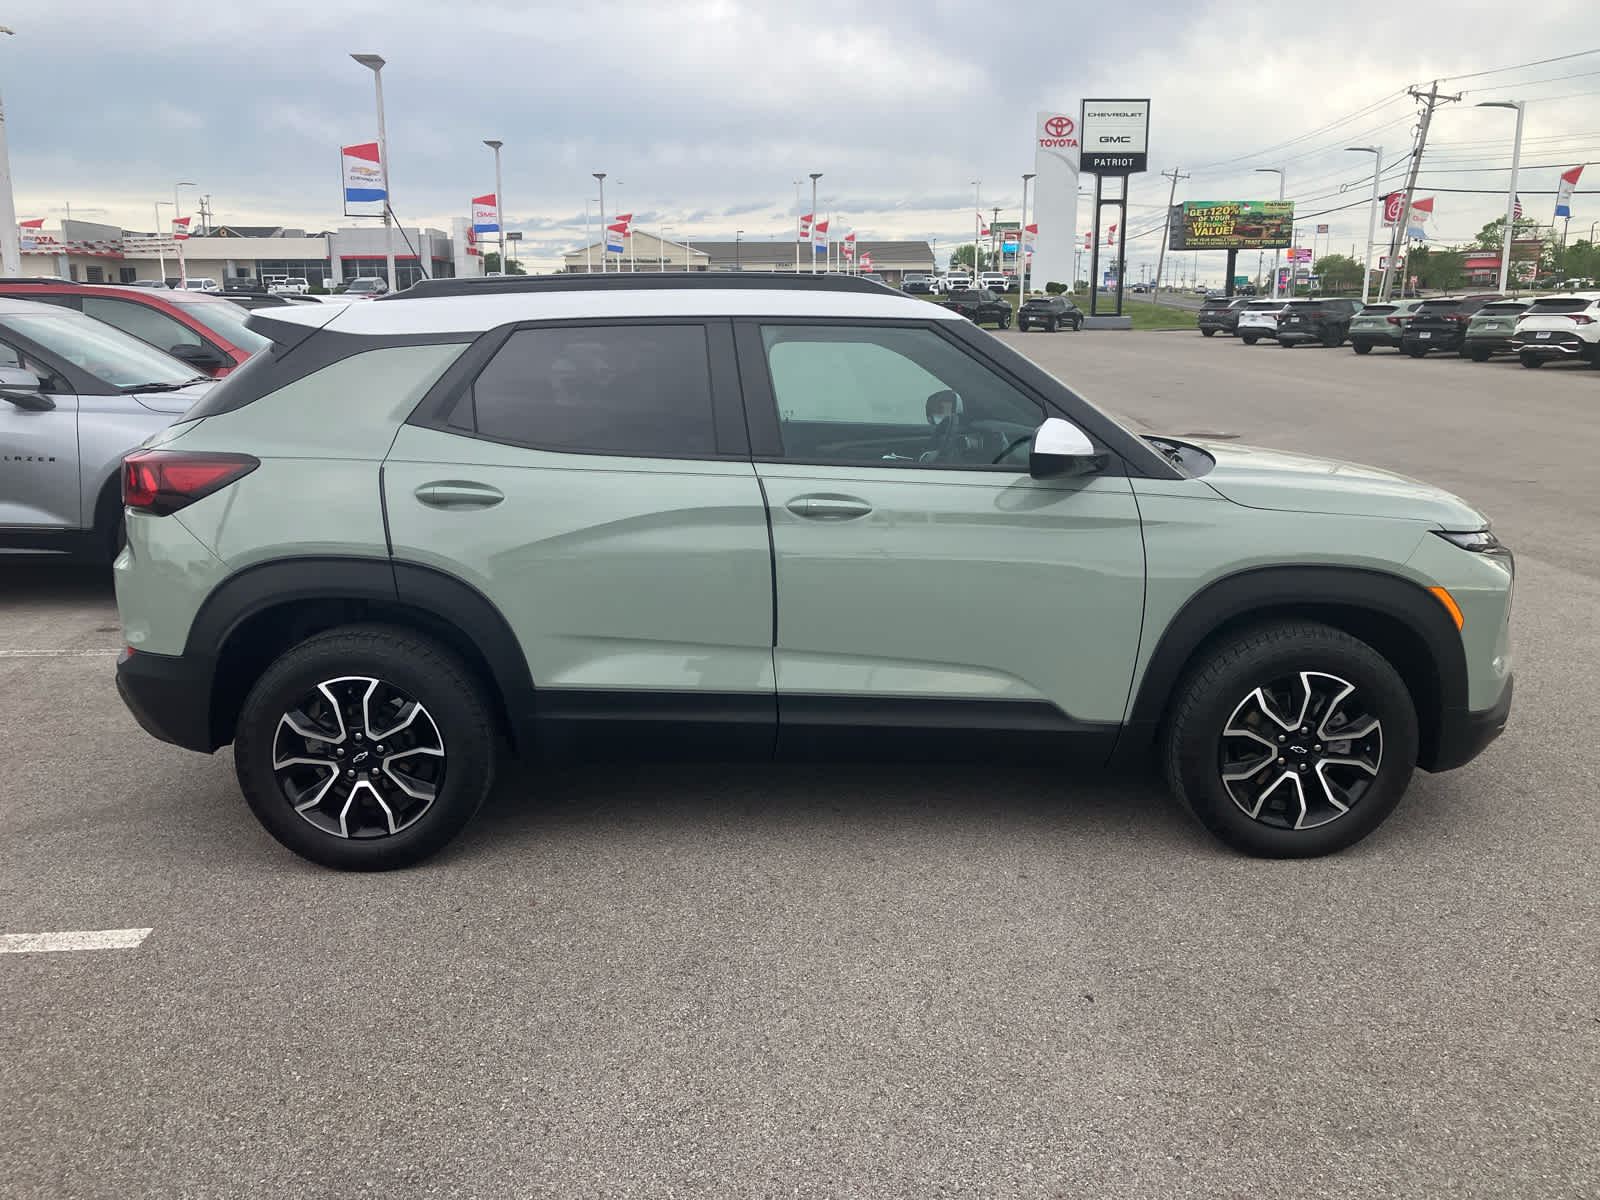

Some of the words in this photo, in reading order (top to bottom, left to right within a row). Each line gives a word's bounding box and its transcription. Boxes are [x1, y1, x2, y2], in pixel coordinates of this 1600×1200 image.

[1039, 139, 1078, 148] TOYOTA
[1094, 158, 1134, 166] PATRIOT
[1210, 204, 1240, 216] 120%
[1193, 226, 1235, 236] VALUE!
